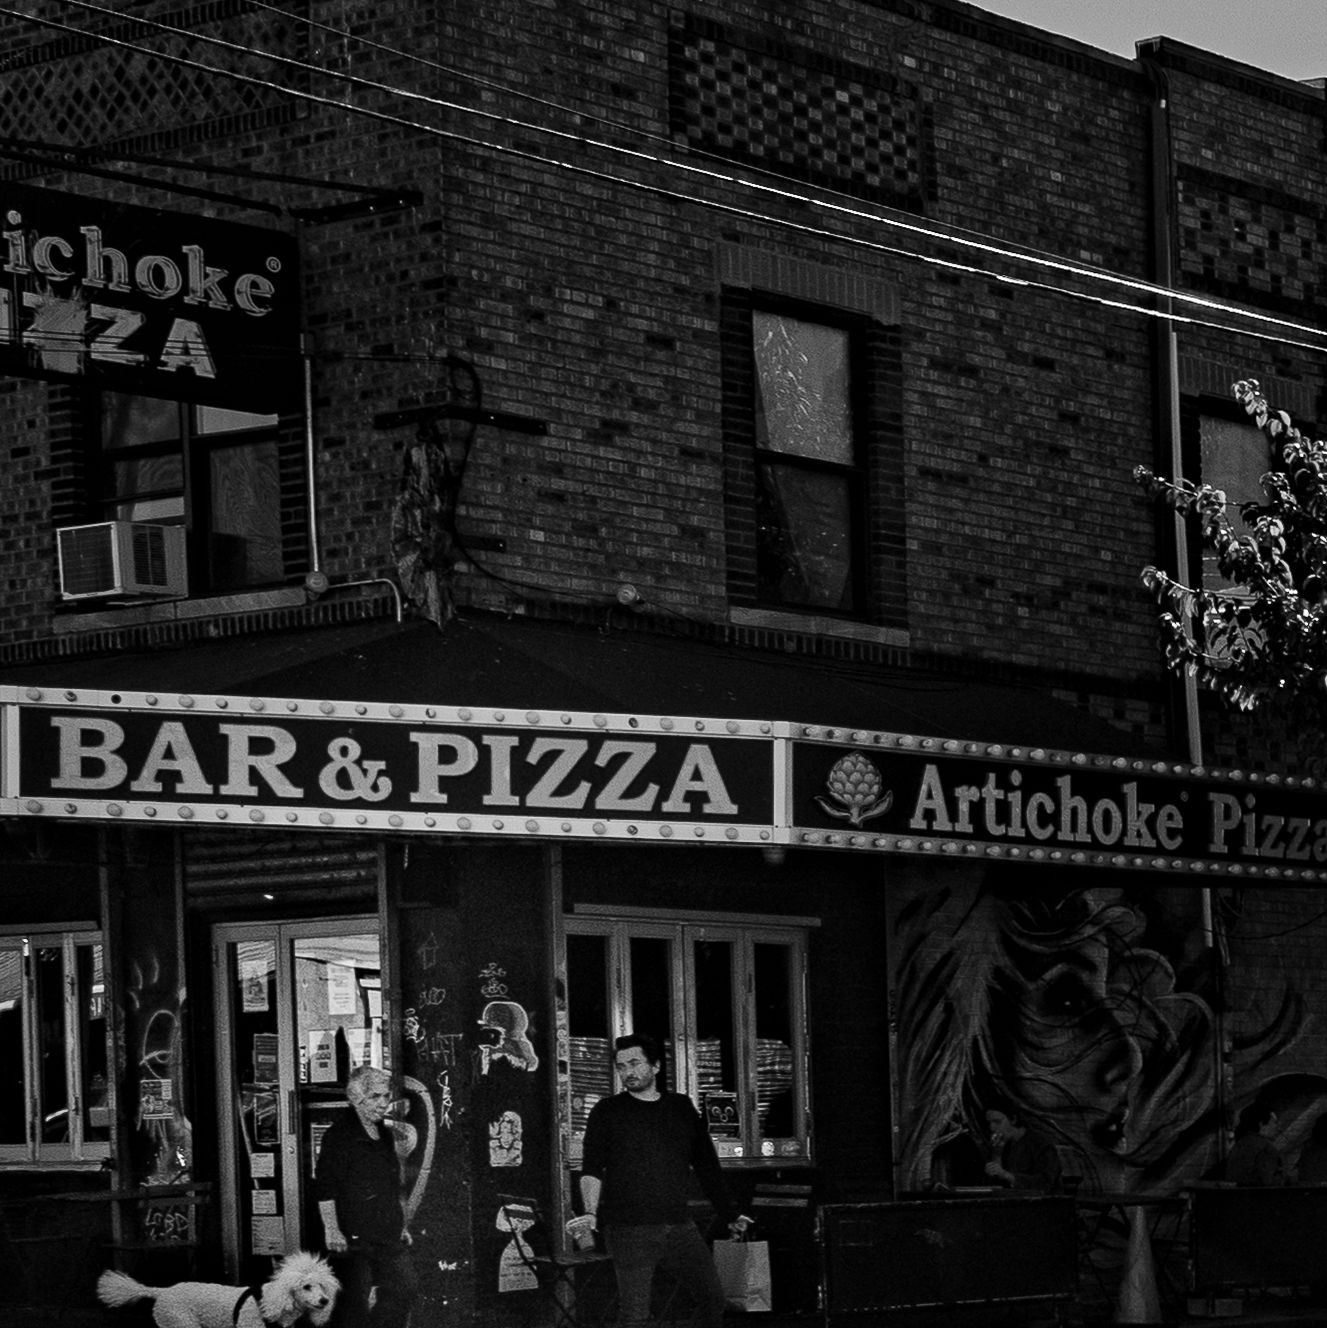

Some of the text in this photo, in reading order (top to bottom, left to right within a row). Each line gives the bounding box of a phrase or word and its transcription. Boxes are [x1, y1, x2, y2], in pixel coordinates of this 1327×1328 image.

[0, 210, 277, 317] ichoke
[50, 716, 739, 815] BAR & PIZZA
[909, 763, 1184, 850] Artichoke
